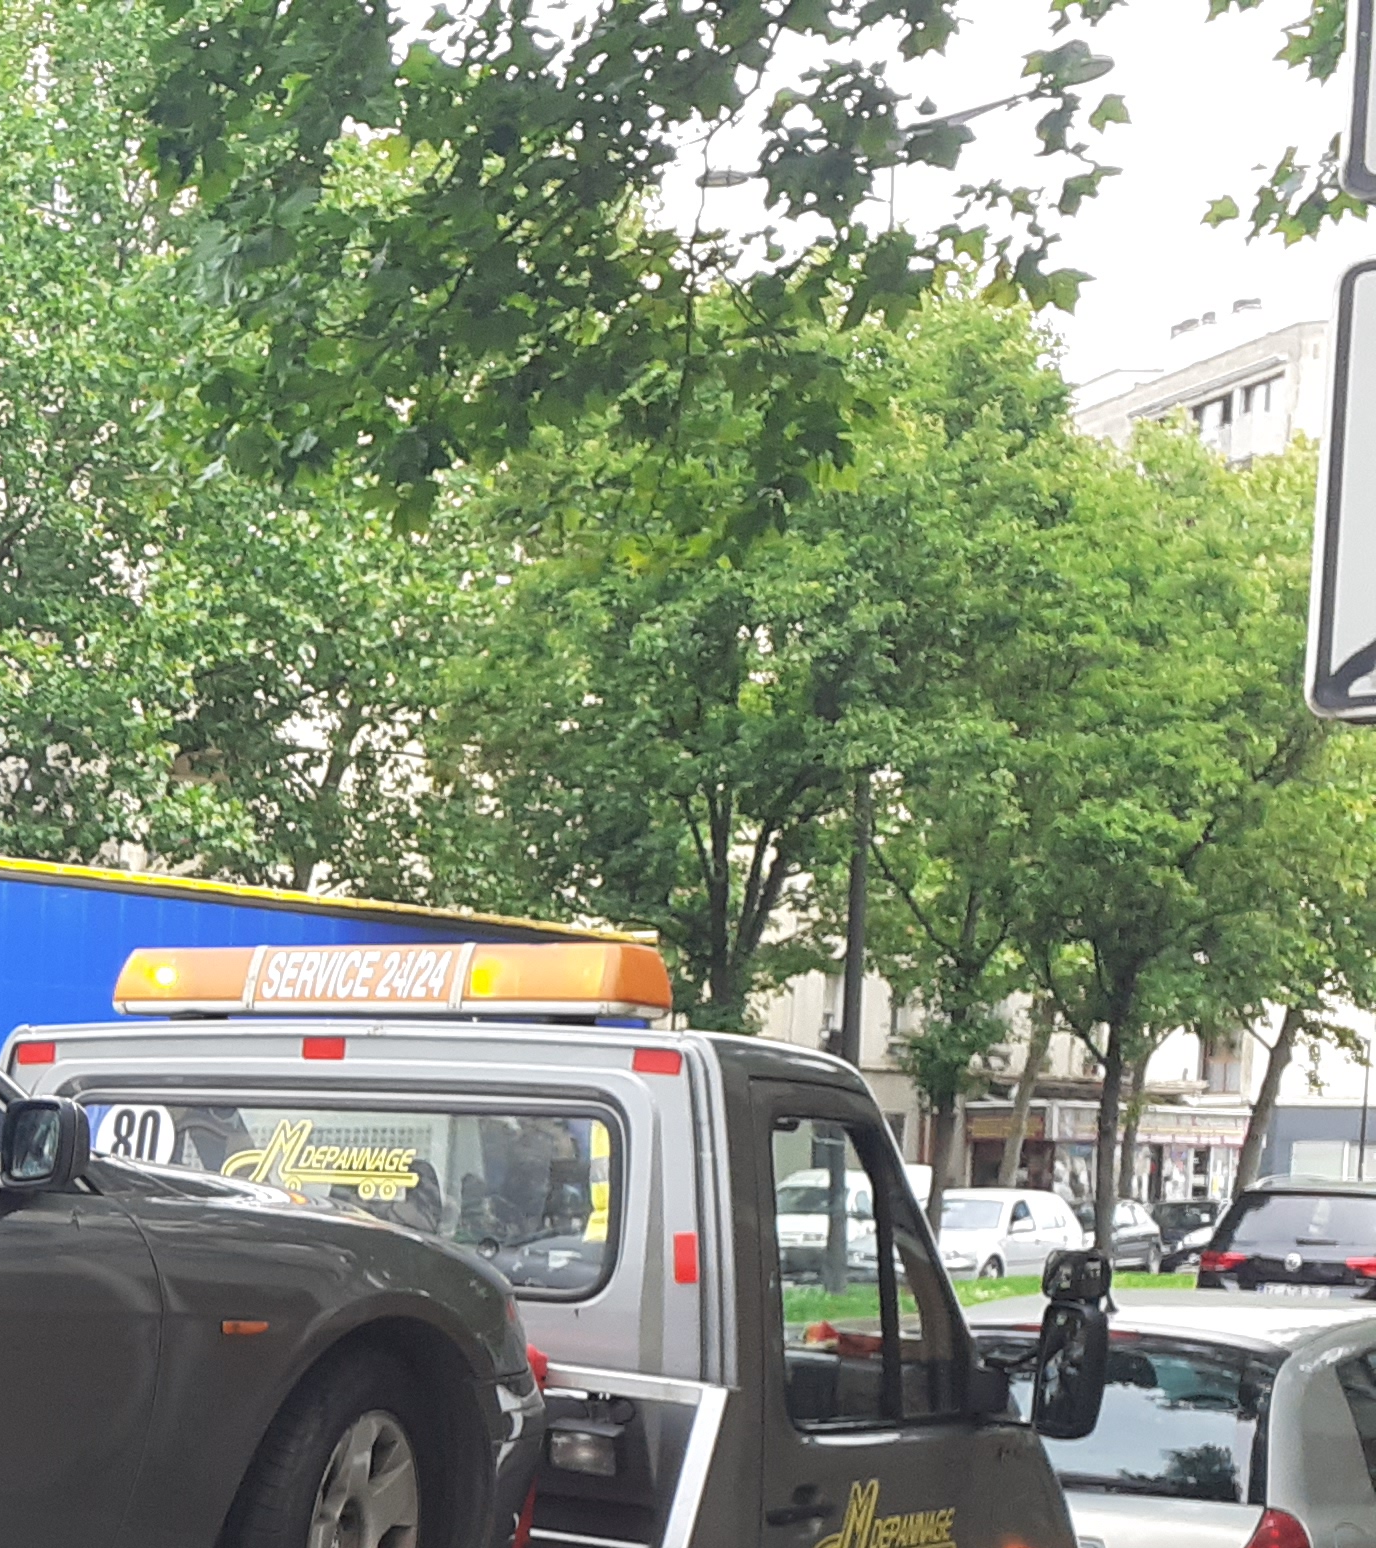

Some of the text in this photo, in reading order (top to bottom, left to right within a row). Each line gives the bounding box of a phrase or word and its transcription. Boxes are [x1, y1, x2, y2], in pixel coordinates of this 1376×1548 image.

[262, 950, 452, 999] SERVICE 24/24
[110, 1108, 161, 1160] 80
[299, 1145, 416, 1172] DEPANNAGE
